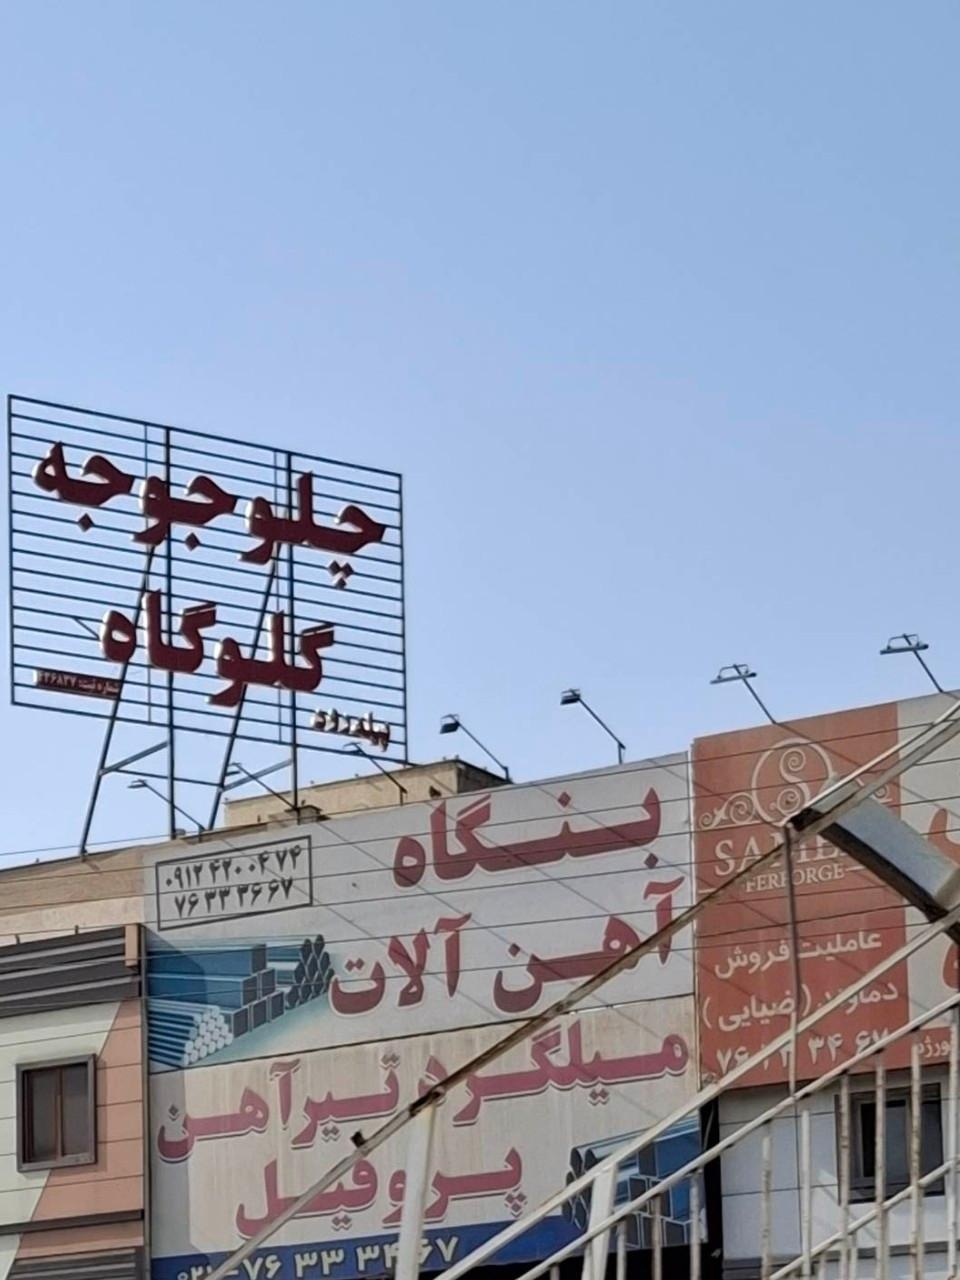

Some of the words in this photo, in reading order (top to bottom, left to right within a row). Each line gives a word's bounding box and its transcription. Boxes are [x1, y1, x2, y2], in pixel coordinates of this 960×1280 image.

[100, 588, 336, 708] گلوگاه
[392, 786, 662, 889] بنگاه
[329, 912, 473, 1016] آلات
[493, 875, 687, 1014] آهن
[714, 939, 790, 980] فروش
[797, 928, 883, 961] عاملیت
[417, 1018, 690, 1126] میلگرد
[235, 1147, 524, 1240] پروفیل
